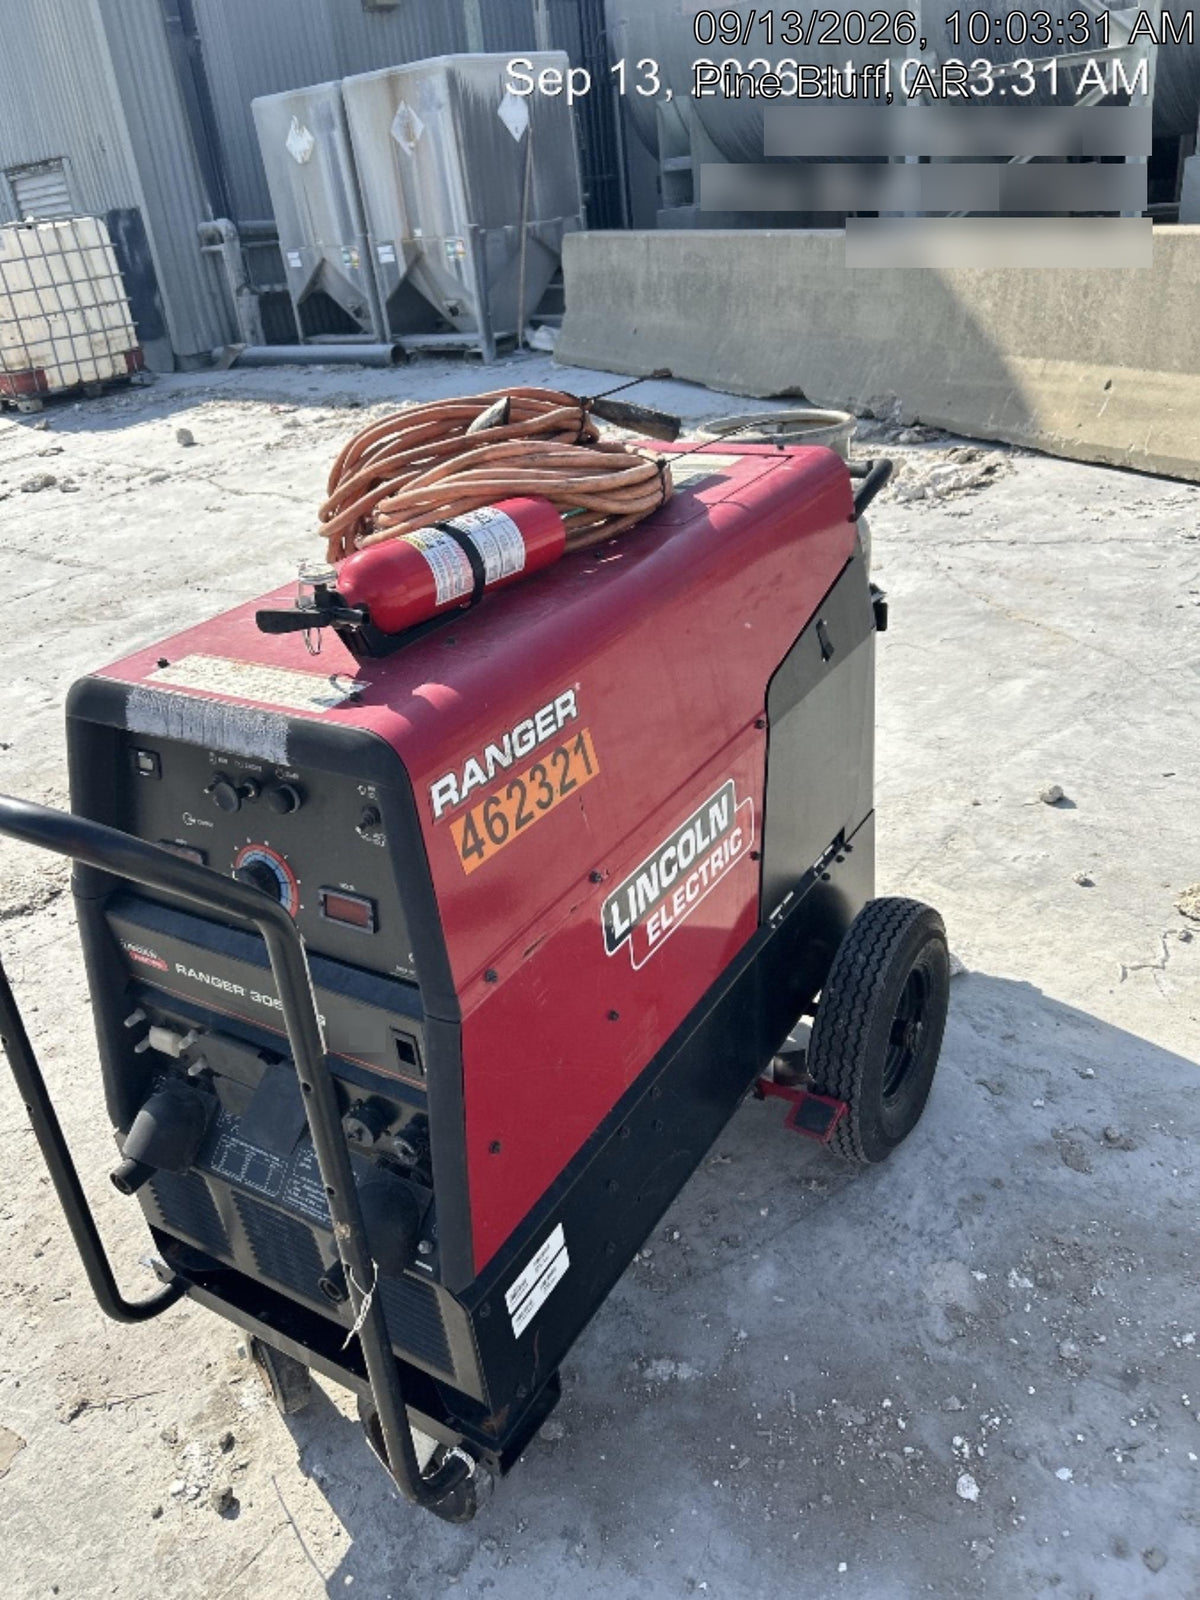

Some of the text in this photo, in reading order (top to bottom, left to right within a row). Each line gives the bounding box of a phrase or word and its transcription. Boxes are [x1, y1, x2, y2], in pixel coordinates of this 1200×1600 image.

[429, 688, 579, 819] RANGER
[459, 730, 595, 861] 462321
[607, 794, 731, 940] LINCOLN
[645, 826, 744, 947] ELECTRIC
[174, 961, 246, 998] RANGER
